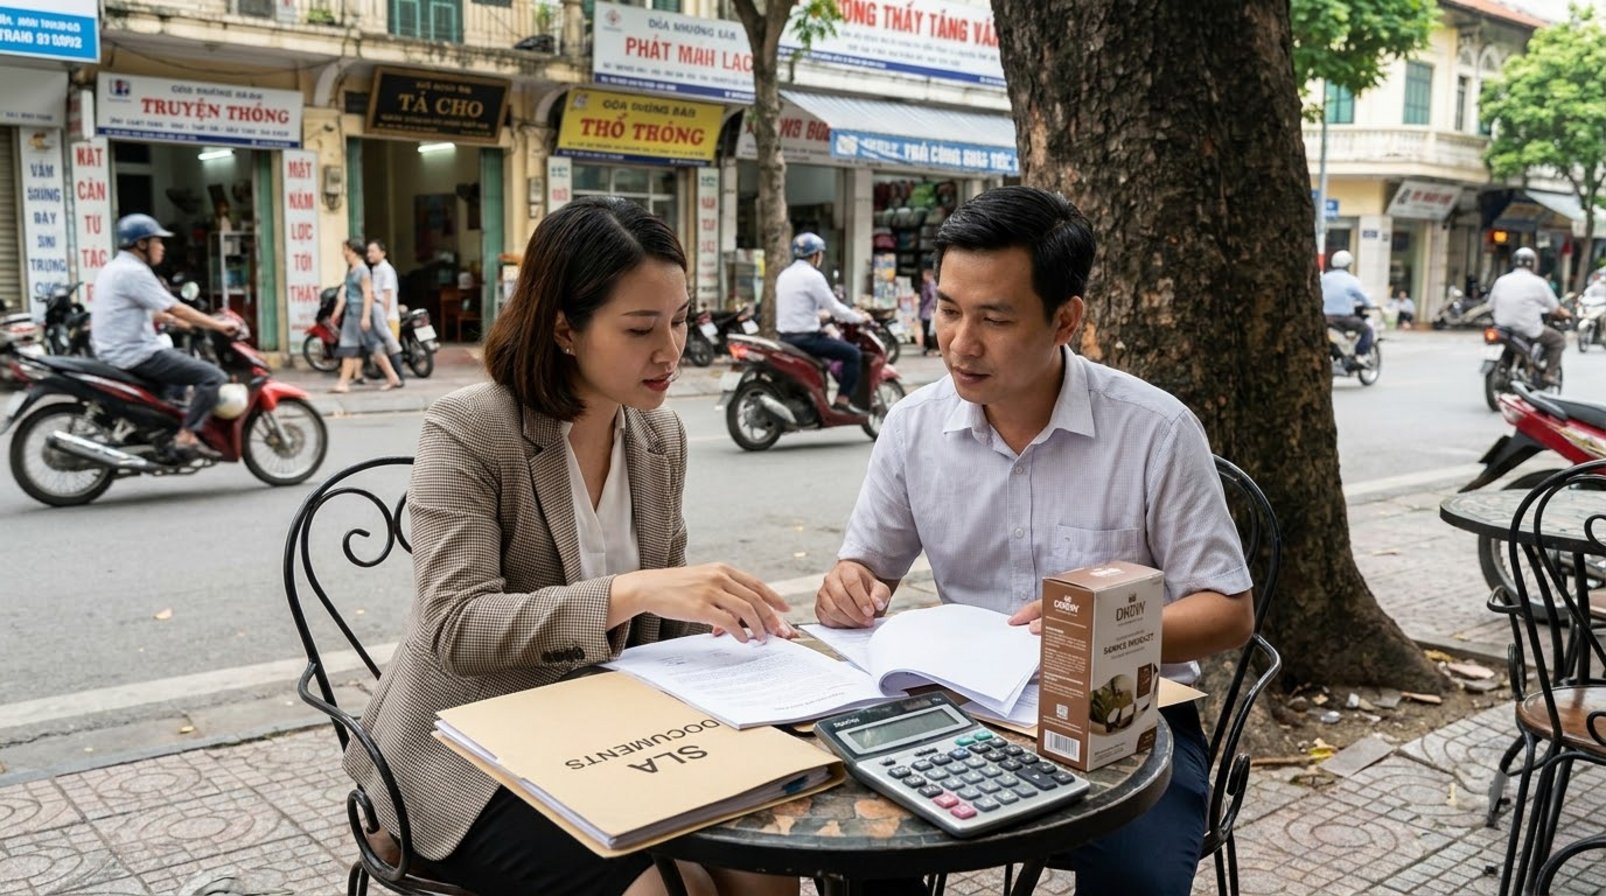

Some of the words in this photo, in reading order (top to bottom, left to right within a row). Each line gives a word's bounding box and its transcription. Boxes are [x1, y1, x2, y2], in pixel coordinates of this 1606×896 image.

[435, 97, 483, 118] CHO
[565, 719, 720, 770] DOCUMENTS
[627, 745, 708, 773] SLA
